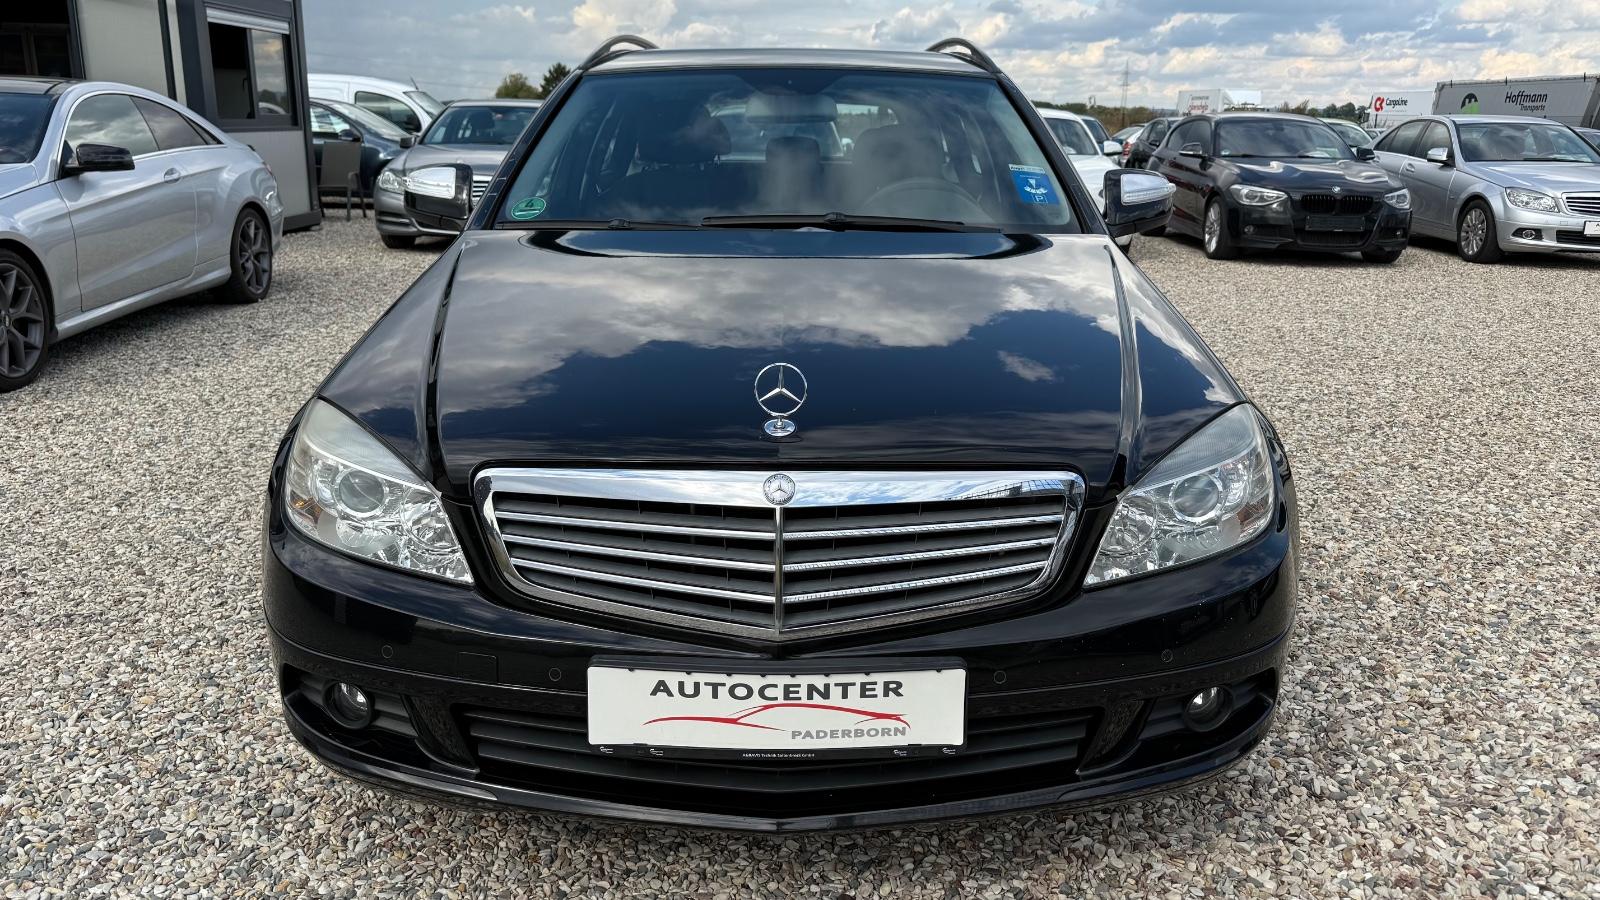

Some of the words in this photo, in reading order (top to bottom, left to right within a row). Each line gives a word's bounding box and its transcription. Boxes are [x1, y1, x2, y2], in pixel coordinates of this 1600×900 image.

[1504, 90, 1548, 106] Hoffmann
[1519, 103, 1546, 112] Transporte
[649, 679, 905, 701] AUTOCENTER
[790, 726, 907, 740] PADERBORN
